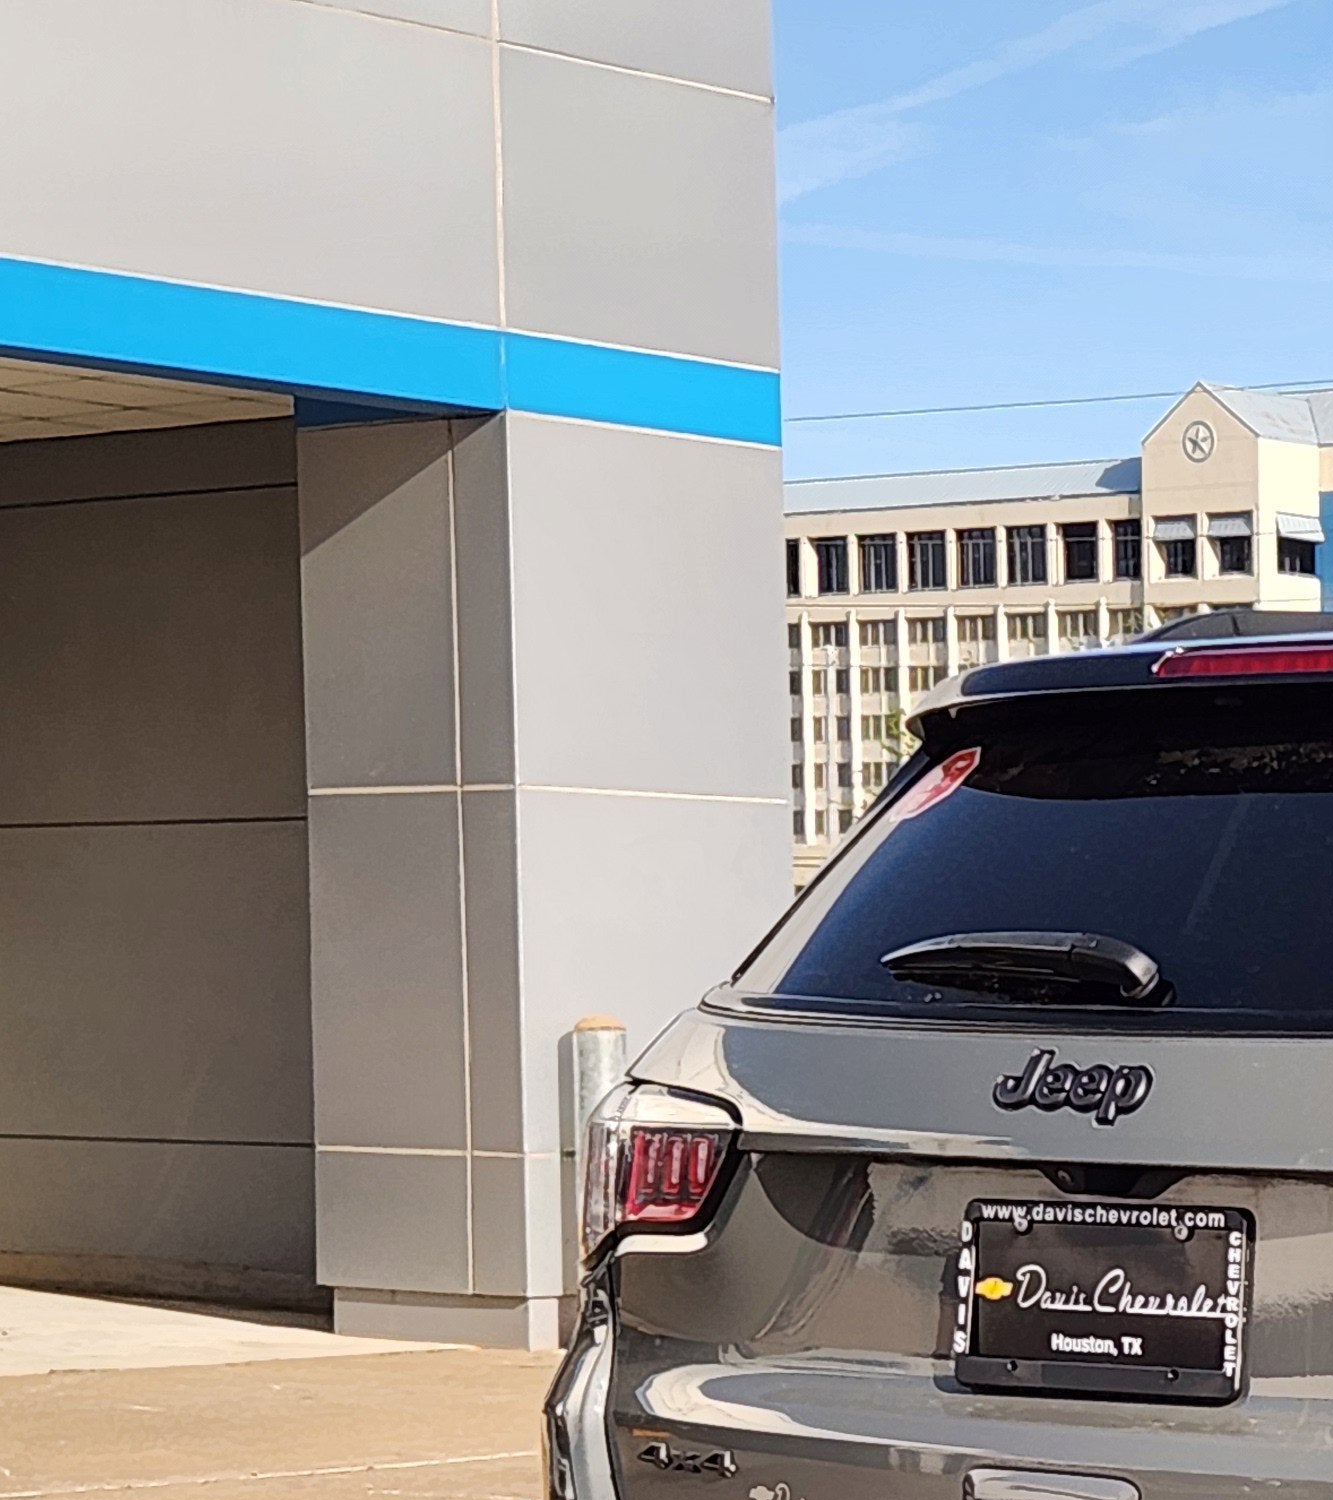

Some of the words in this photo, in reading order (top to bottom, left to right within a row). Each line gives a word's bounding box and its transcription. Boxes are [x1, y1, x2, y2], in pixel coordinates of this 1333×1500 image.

[993, 1048, 1155, 1126] Jeep
[981, 1203, 1225, 1228] www.davischevrolet.com
[953, 1221, 971, 1353] DAVIS
[1016, 1265, 1092, 1311] Davis
[1223, 1231, 1243, 1376] CHEVROLET
[1051, 1333, 1118, 1356] Houston,
[1121, 1337, 1143, 1355] TX
